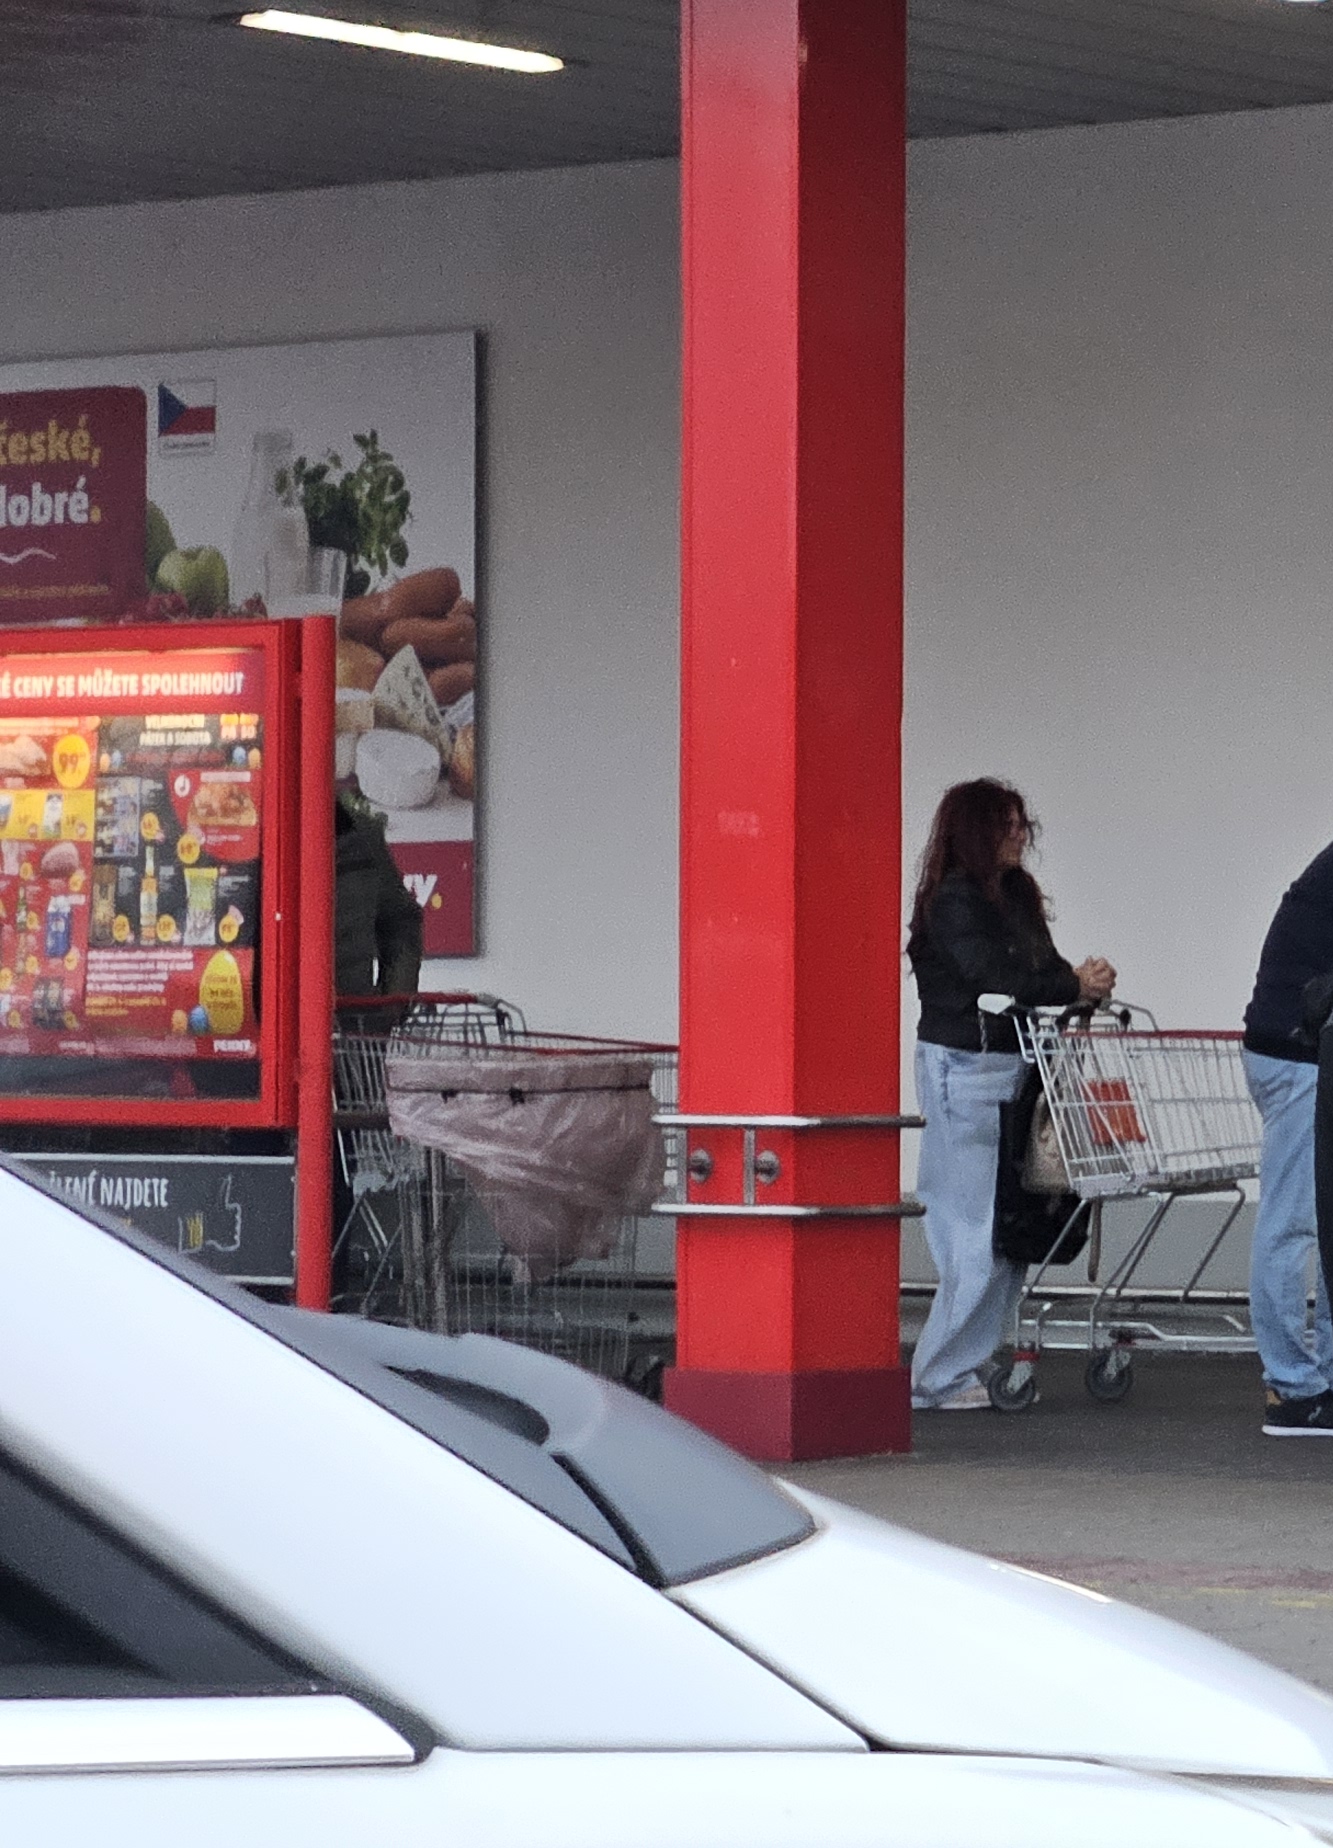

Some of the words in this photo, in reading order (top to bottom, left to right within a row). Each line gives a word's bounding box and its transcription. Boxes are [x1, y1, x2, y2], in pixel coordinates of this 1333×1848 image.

[13, 675, 54, 699] CENY
[56, 674, 75, 699] SE
[78, 667, 139, 698] MŮŽETE
[141, 671, 245, 697] SPOLEHNOUT
[100, 1176, 170, 1211] NAJDETE
